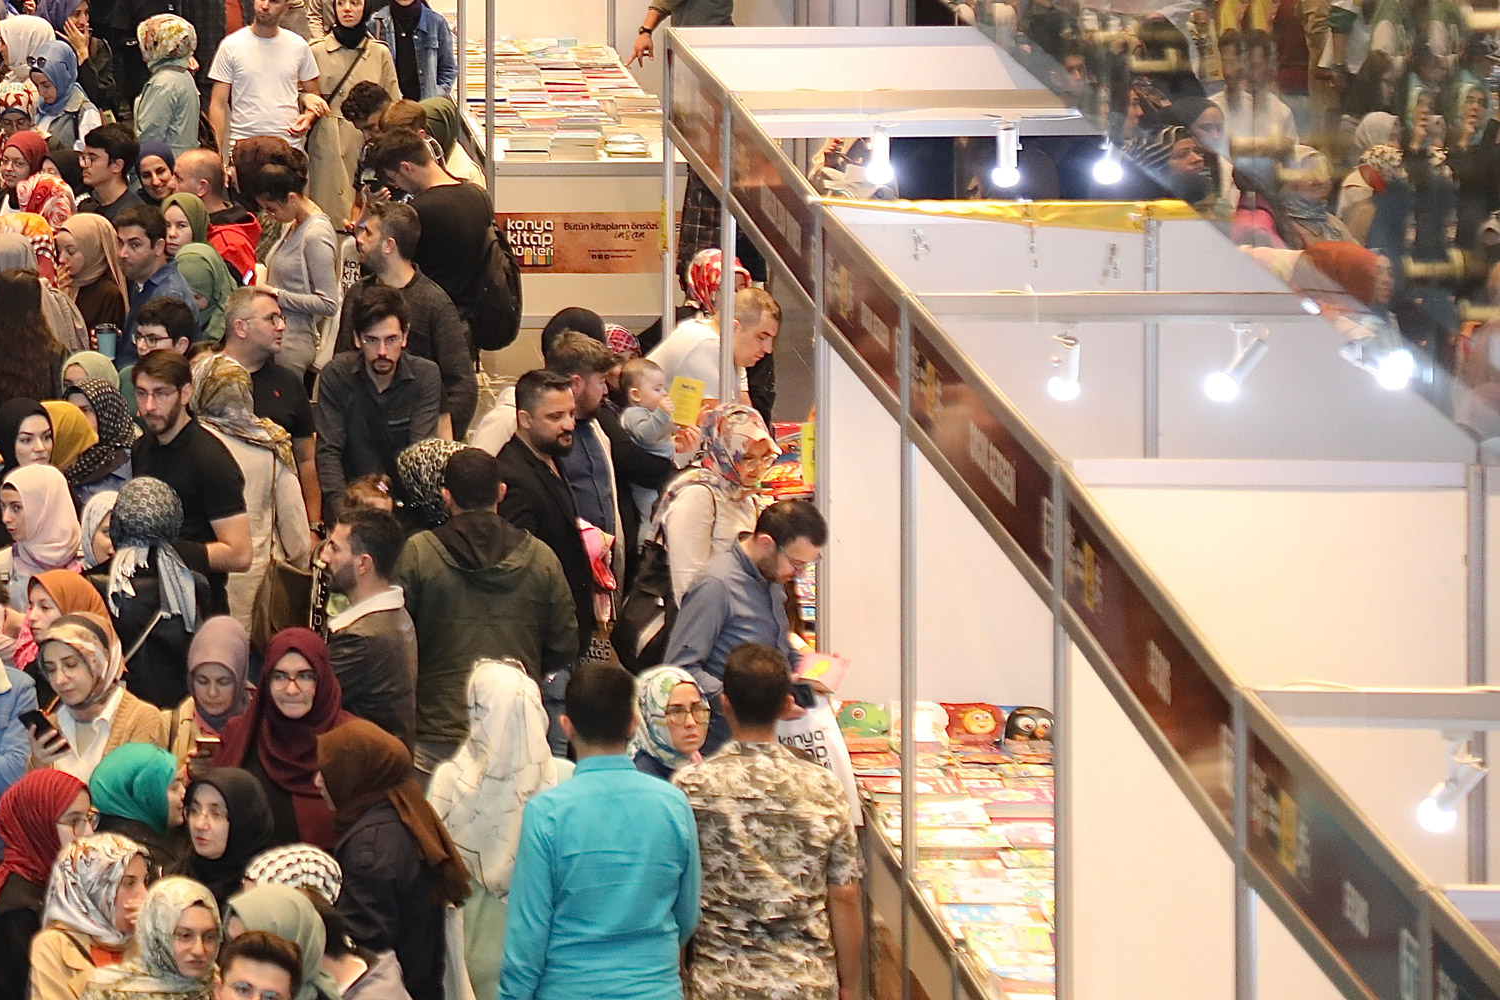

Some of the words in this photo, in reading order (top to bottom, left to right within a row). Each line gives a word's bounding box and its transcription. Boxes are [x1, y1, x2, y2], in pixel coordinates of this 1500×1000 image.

[506, 218, 554, 233] konya
[563, 223, 590, 231] Bütün
[590, 223, 630, 232] kitapların
[506, 231, 554, 247] kitap
[511, 246, 554, 257] ünleri
